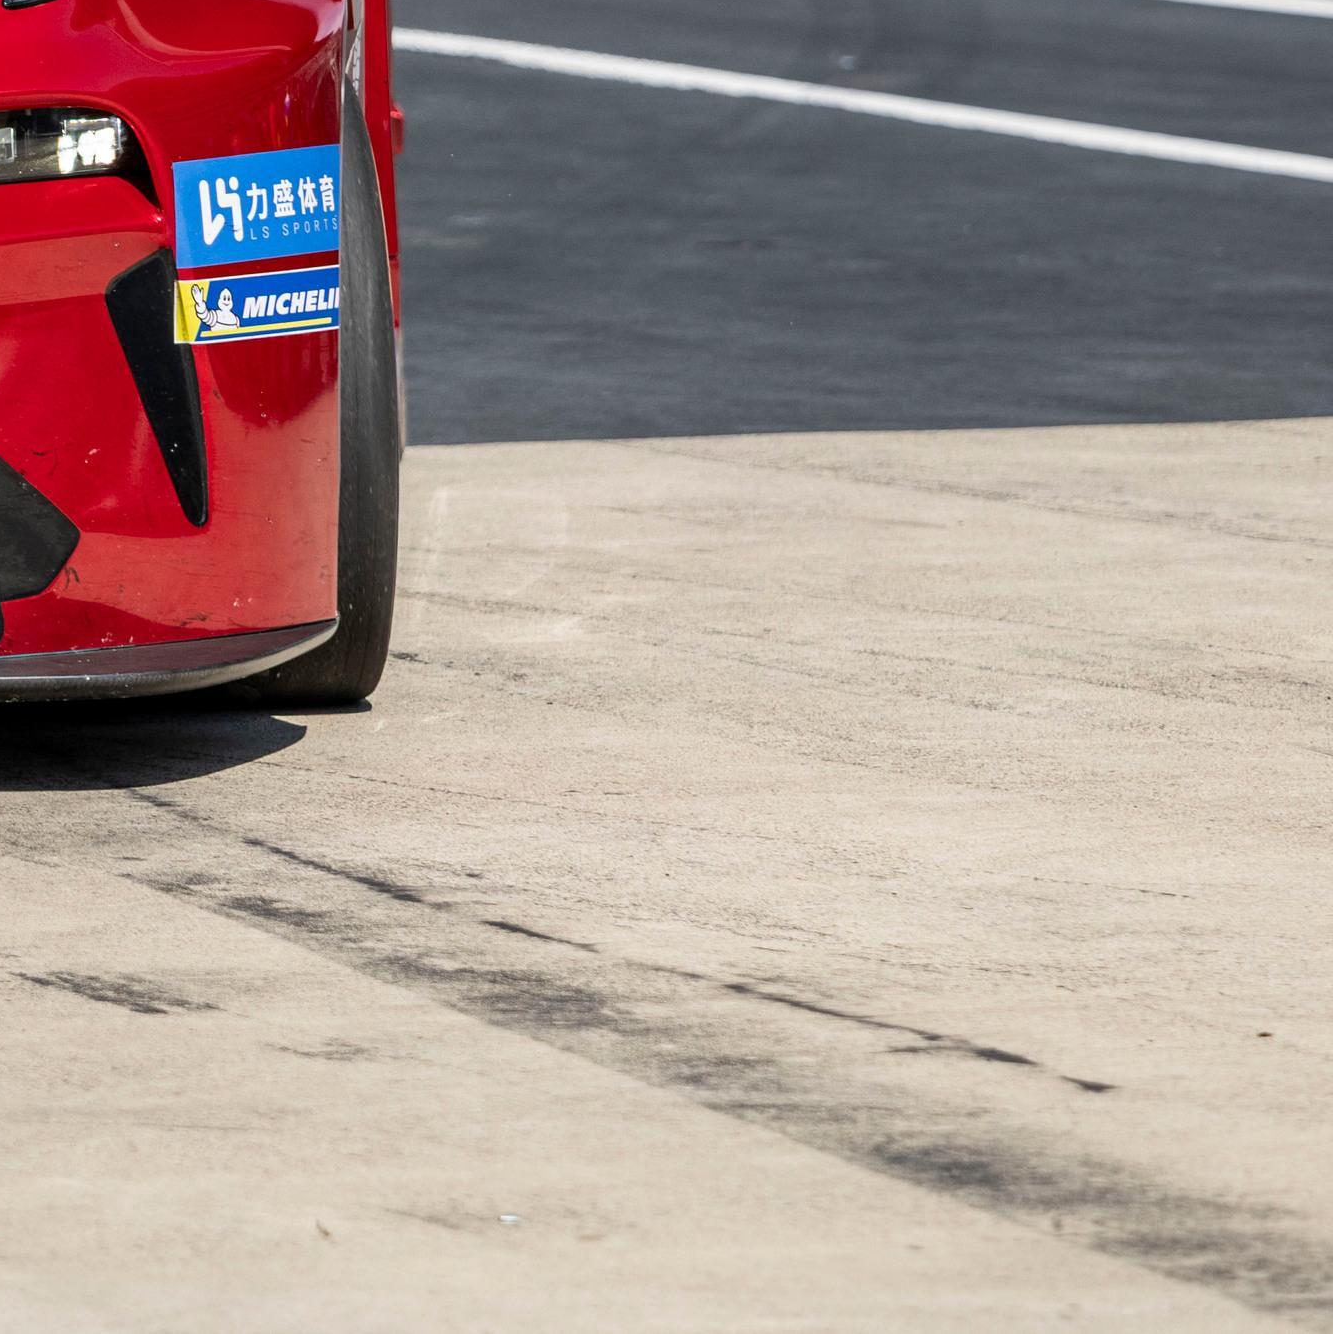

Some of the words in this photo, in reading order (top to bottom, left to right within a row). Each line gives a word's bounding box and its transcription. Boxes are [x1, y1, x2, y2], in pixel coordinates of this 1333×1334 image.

[246, 174, 335, 222] 力盛体育
[250, 225, 270, 241] LS
[282, 217, 338, 236] SPORTS
[242, 287, 339, 319] MICHELI
